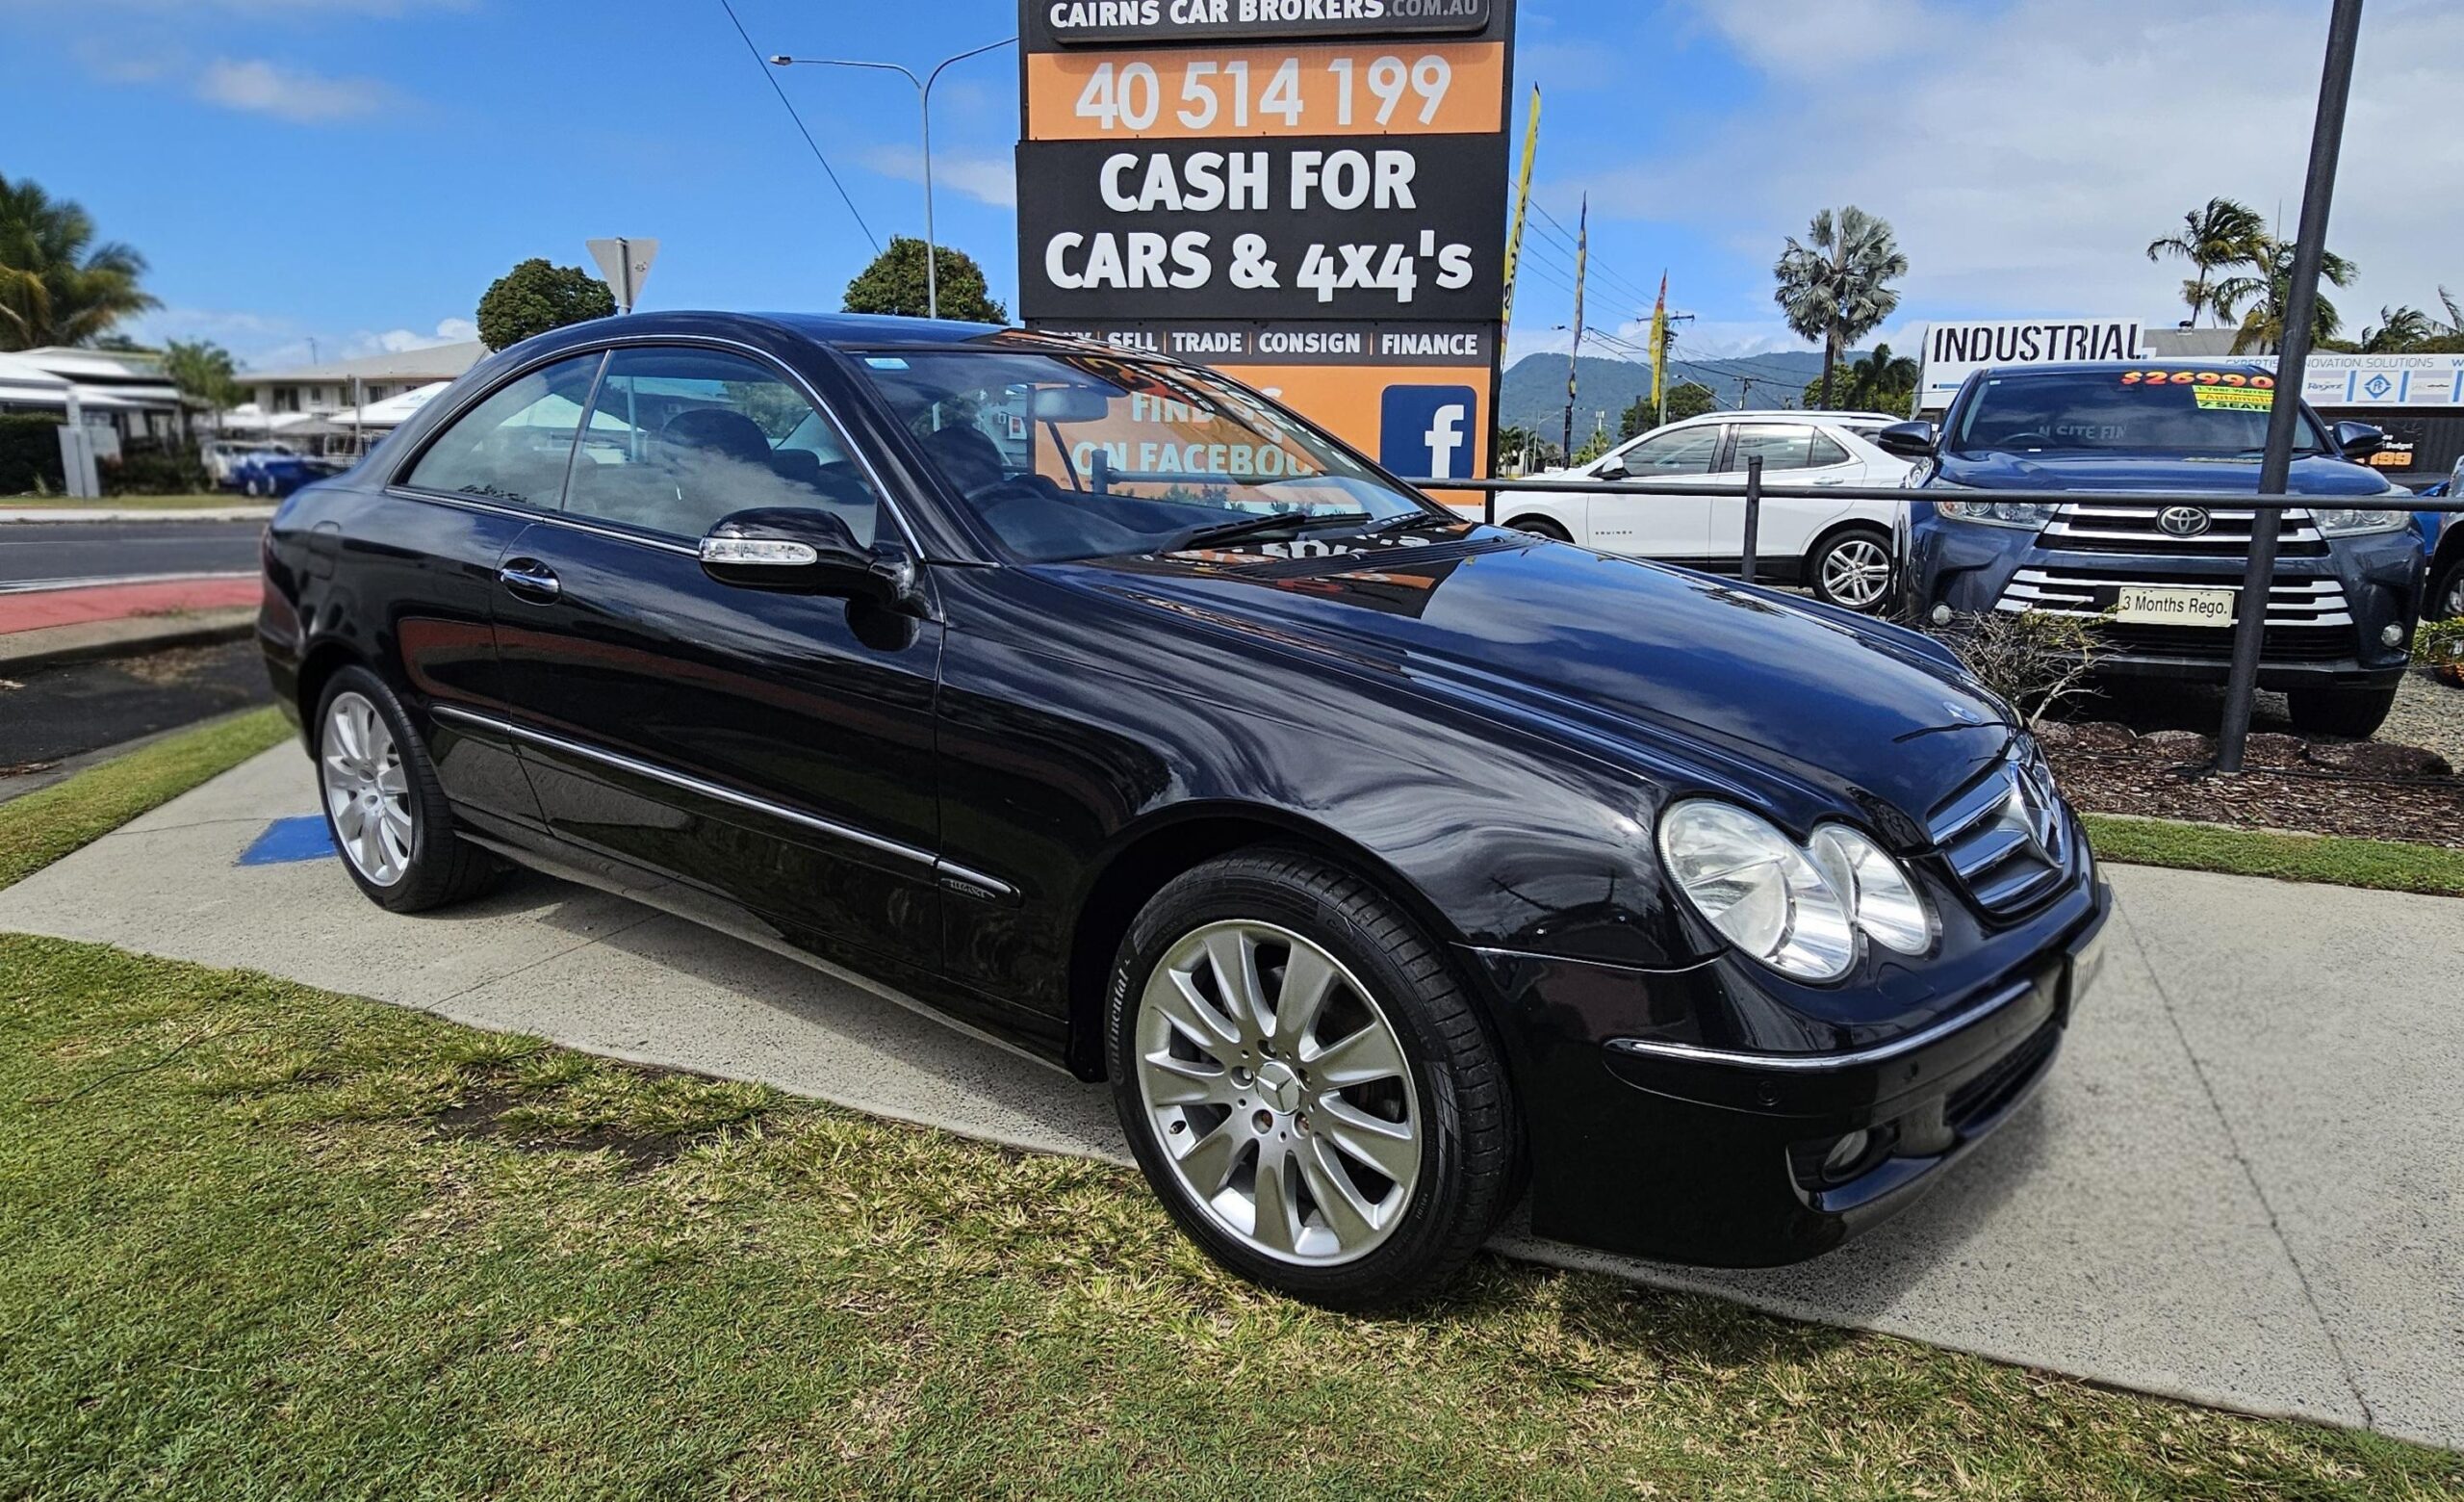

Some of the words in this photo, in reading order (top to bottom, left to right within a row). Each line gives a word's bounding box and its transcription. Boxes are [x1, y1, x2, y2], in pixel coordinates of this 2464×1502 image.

[1050, 1, 1160, 28] CAIRNS
[1170, 0, 1228, 24] CAR
[1076, 62, 1160, 130] 40
[1175, 58, 1303, 130] 514
[1327, 55, 1451, 126] 199
[1100, 151, 1270, 212] CASH
[1291, 149, 1417, 210] FOR
[1045, 231, 1212, 289] CARS
[1229, 233, 1280, 289] &
[1108, 331, 1158, 352] SELL
[1172, 332, 1243, 353] TRADE
[1259, 332, 1360, 353] CONSIGN
[1381, 333, 1477, 355] FINANCE
[2121, 371, 2274, 388] $26990
[1140, 442, 1315, 476] FACEBO
[2123, 596, 2131, 610] 3
[2136, 595, 2184, 612] Months
[2189, 598, 2227, 617] Rego.
